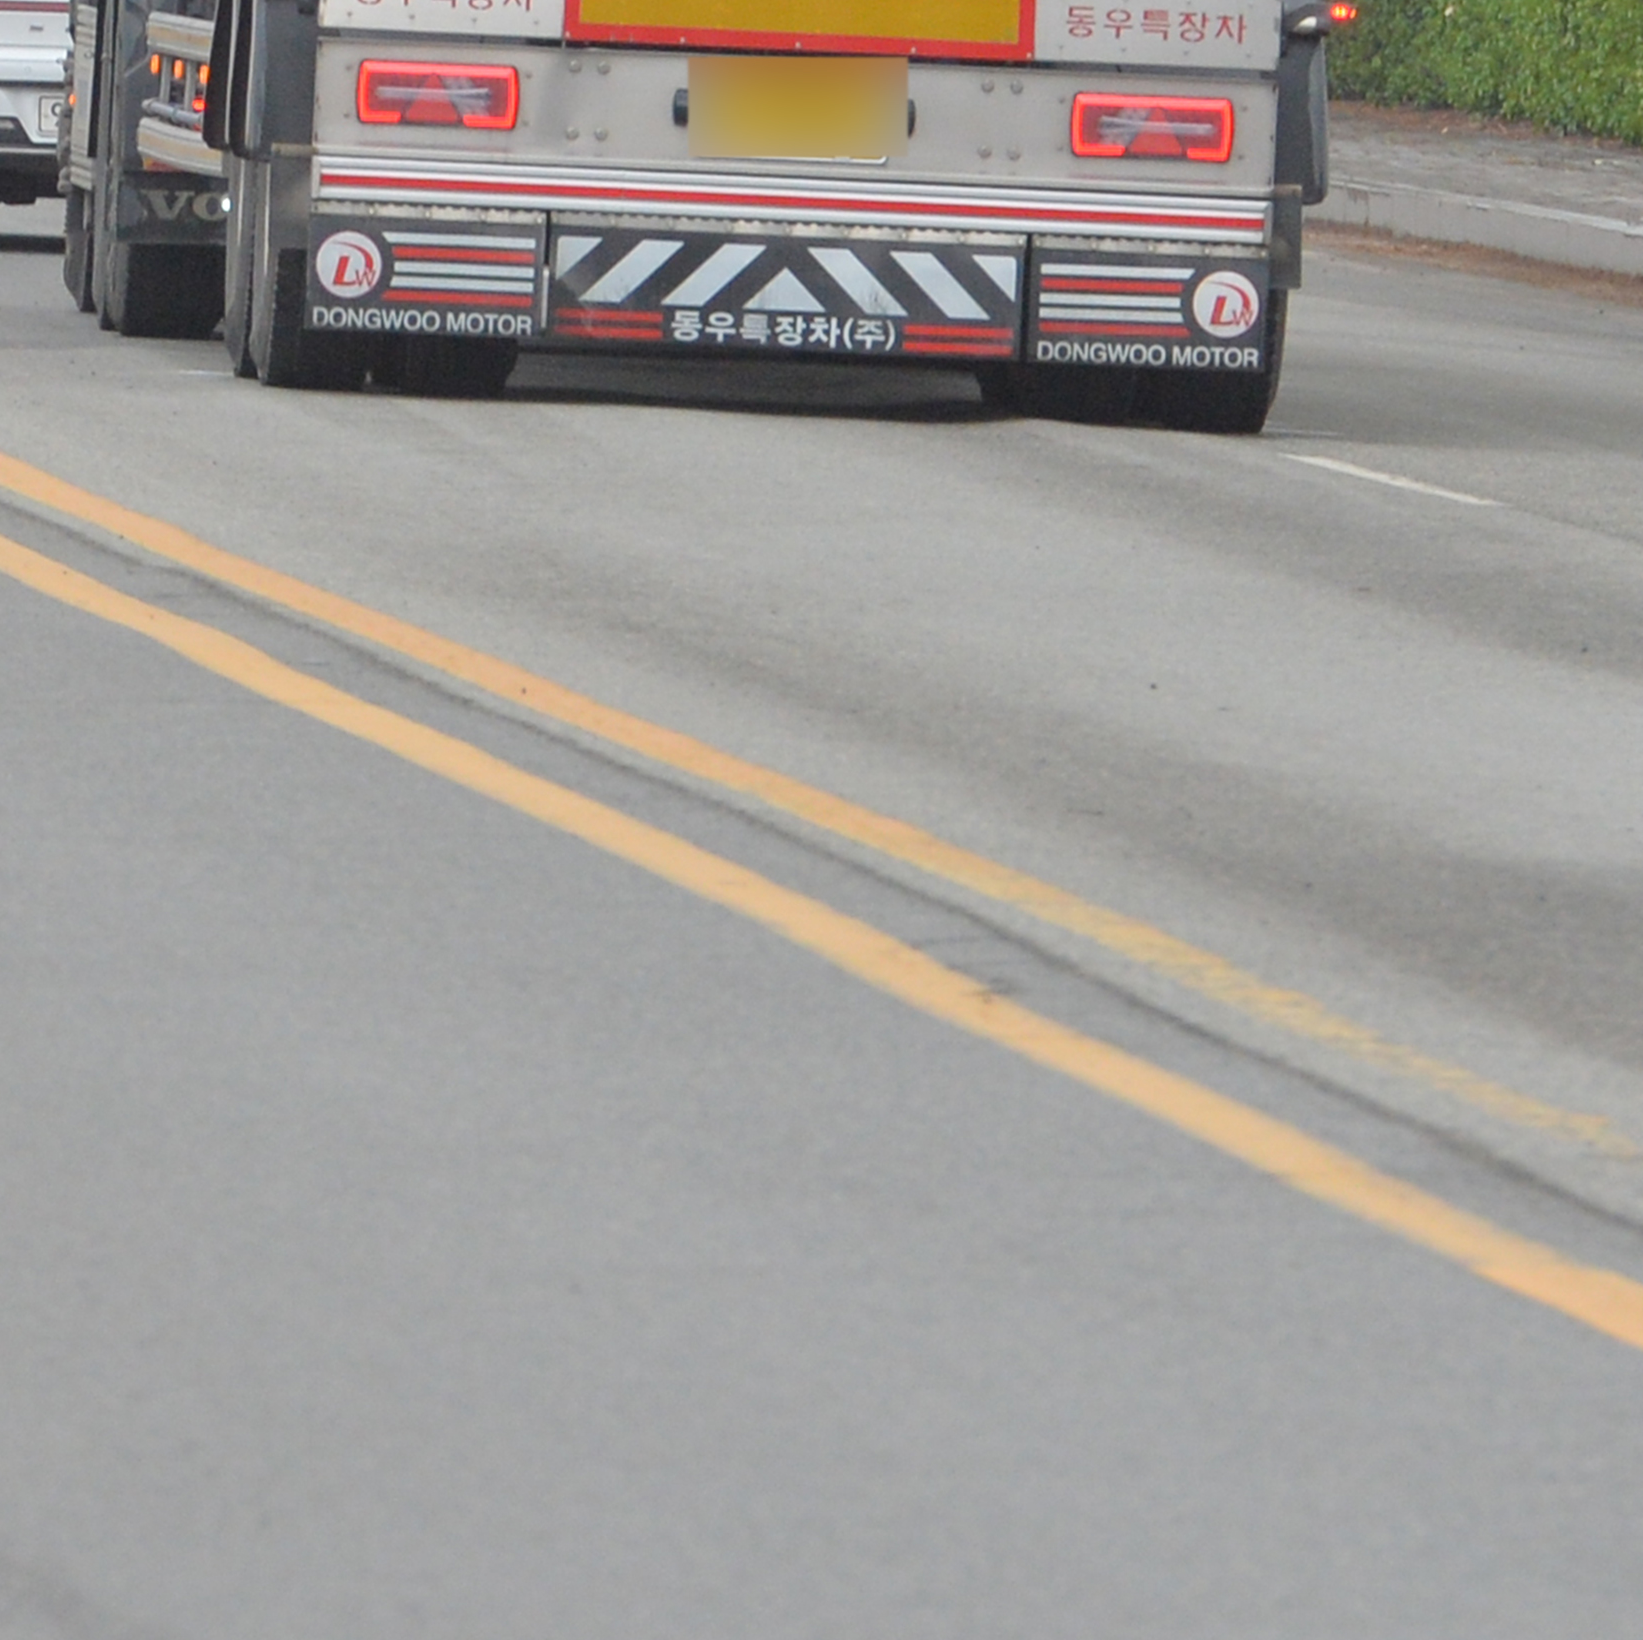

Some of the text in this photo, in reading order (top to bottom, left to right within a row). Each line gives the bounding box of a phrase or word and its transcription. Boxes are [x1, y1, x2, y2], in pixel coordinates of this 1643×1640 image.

[1066, 5, 1247, 45] 동우특장차
[312, 306, 533, 336] DONGWOO MOTOR
[670, 309, 897, 351] 동우특장차(주)
[1036, 340, 1259, 368] DONGWOO MOTOR
